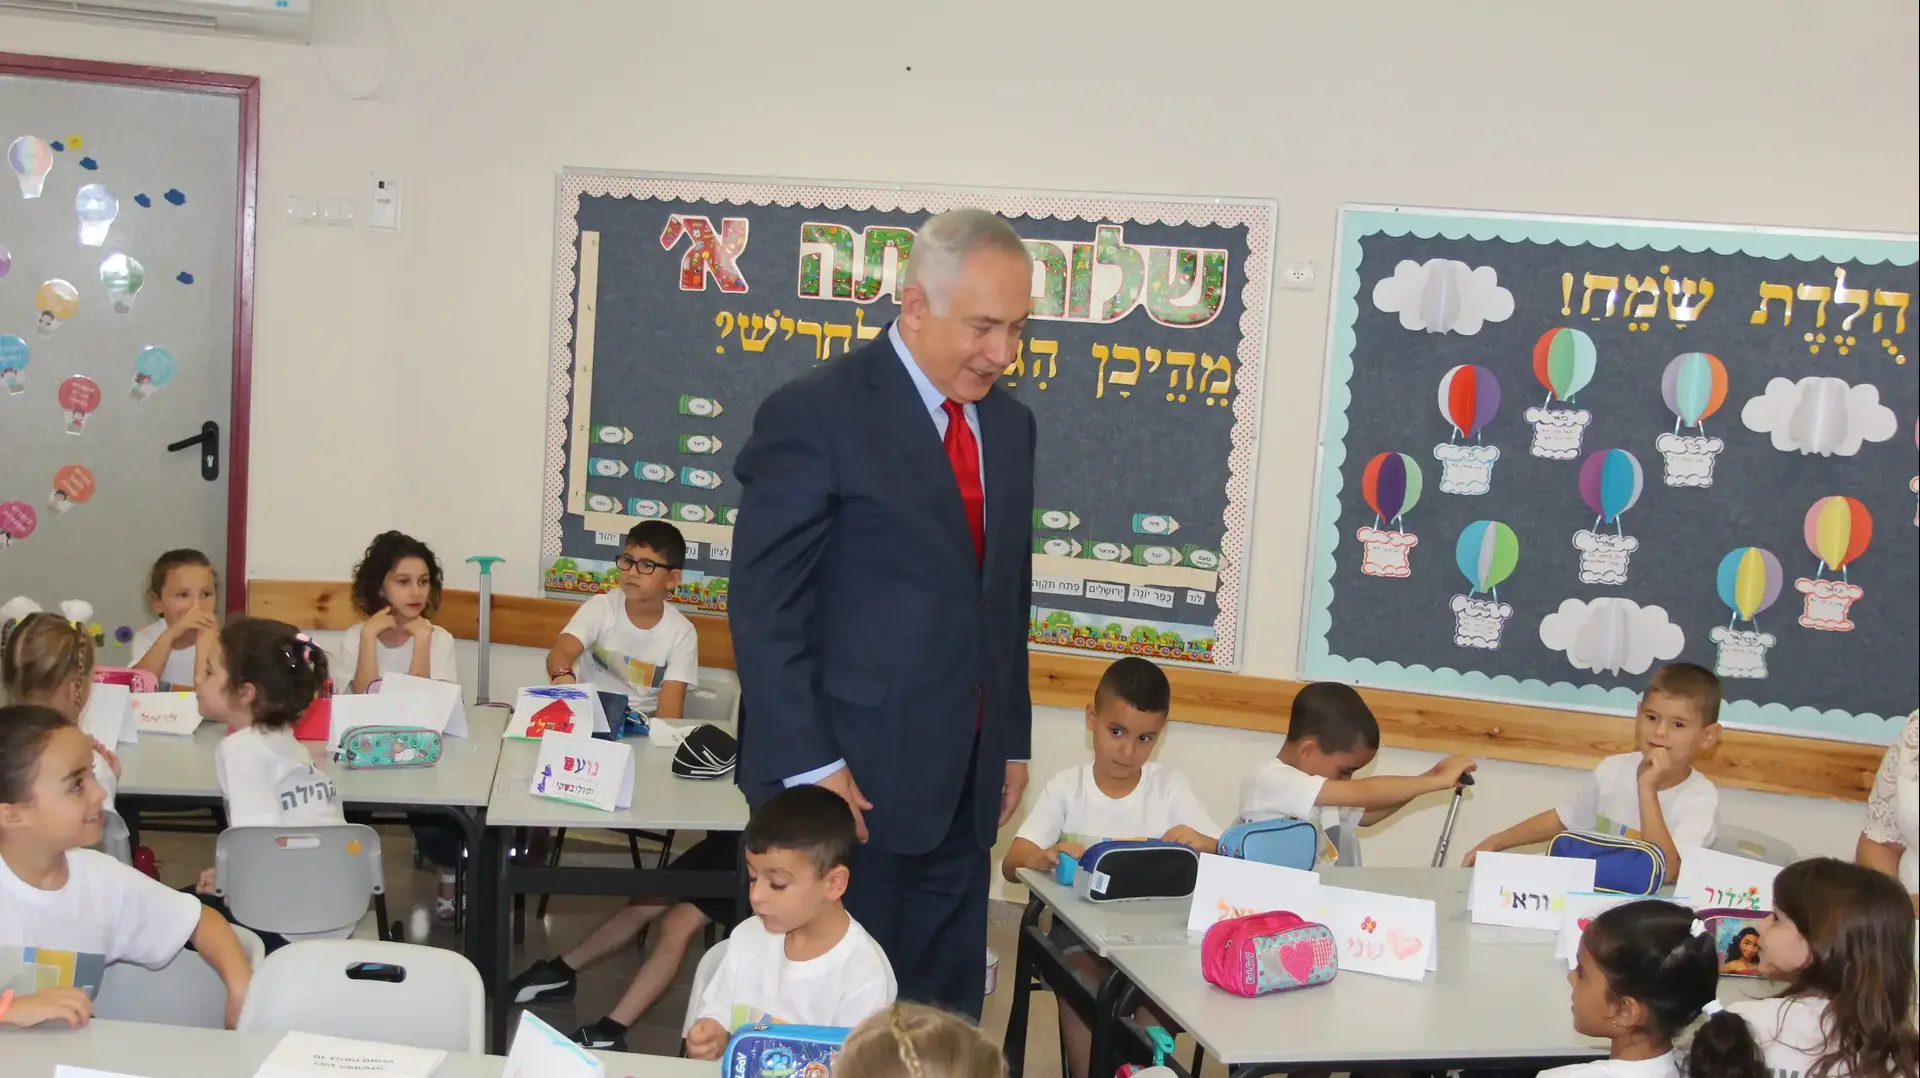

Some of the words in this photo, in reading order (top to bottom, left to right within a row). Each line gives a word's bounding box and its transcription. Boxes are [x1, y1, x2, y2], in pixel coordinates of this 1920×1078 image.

[798, 222, 918, 304] תה
[563, 756, 599, 776] נועם
[1347, 936, 1385, 960] שני
